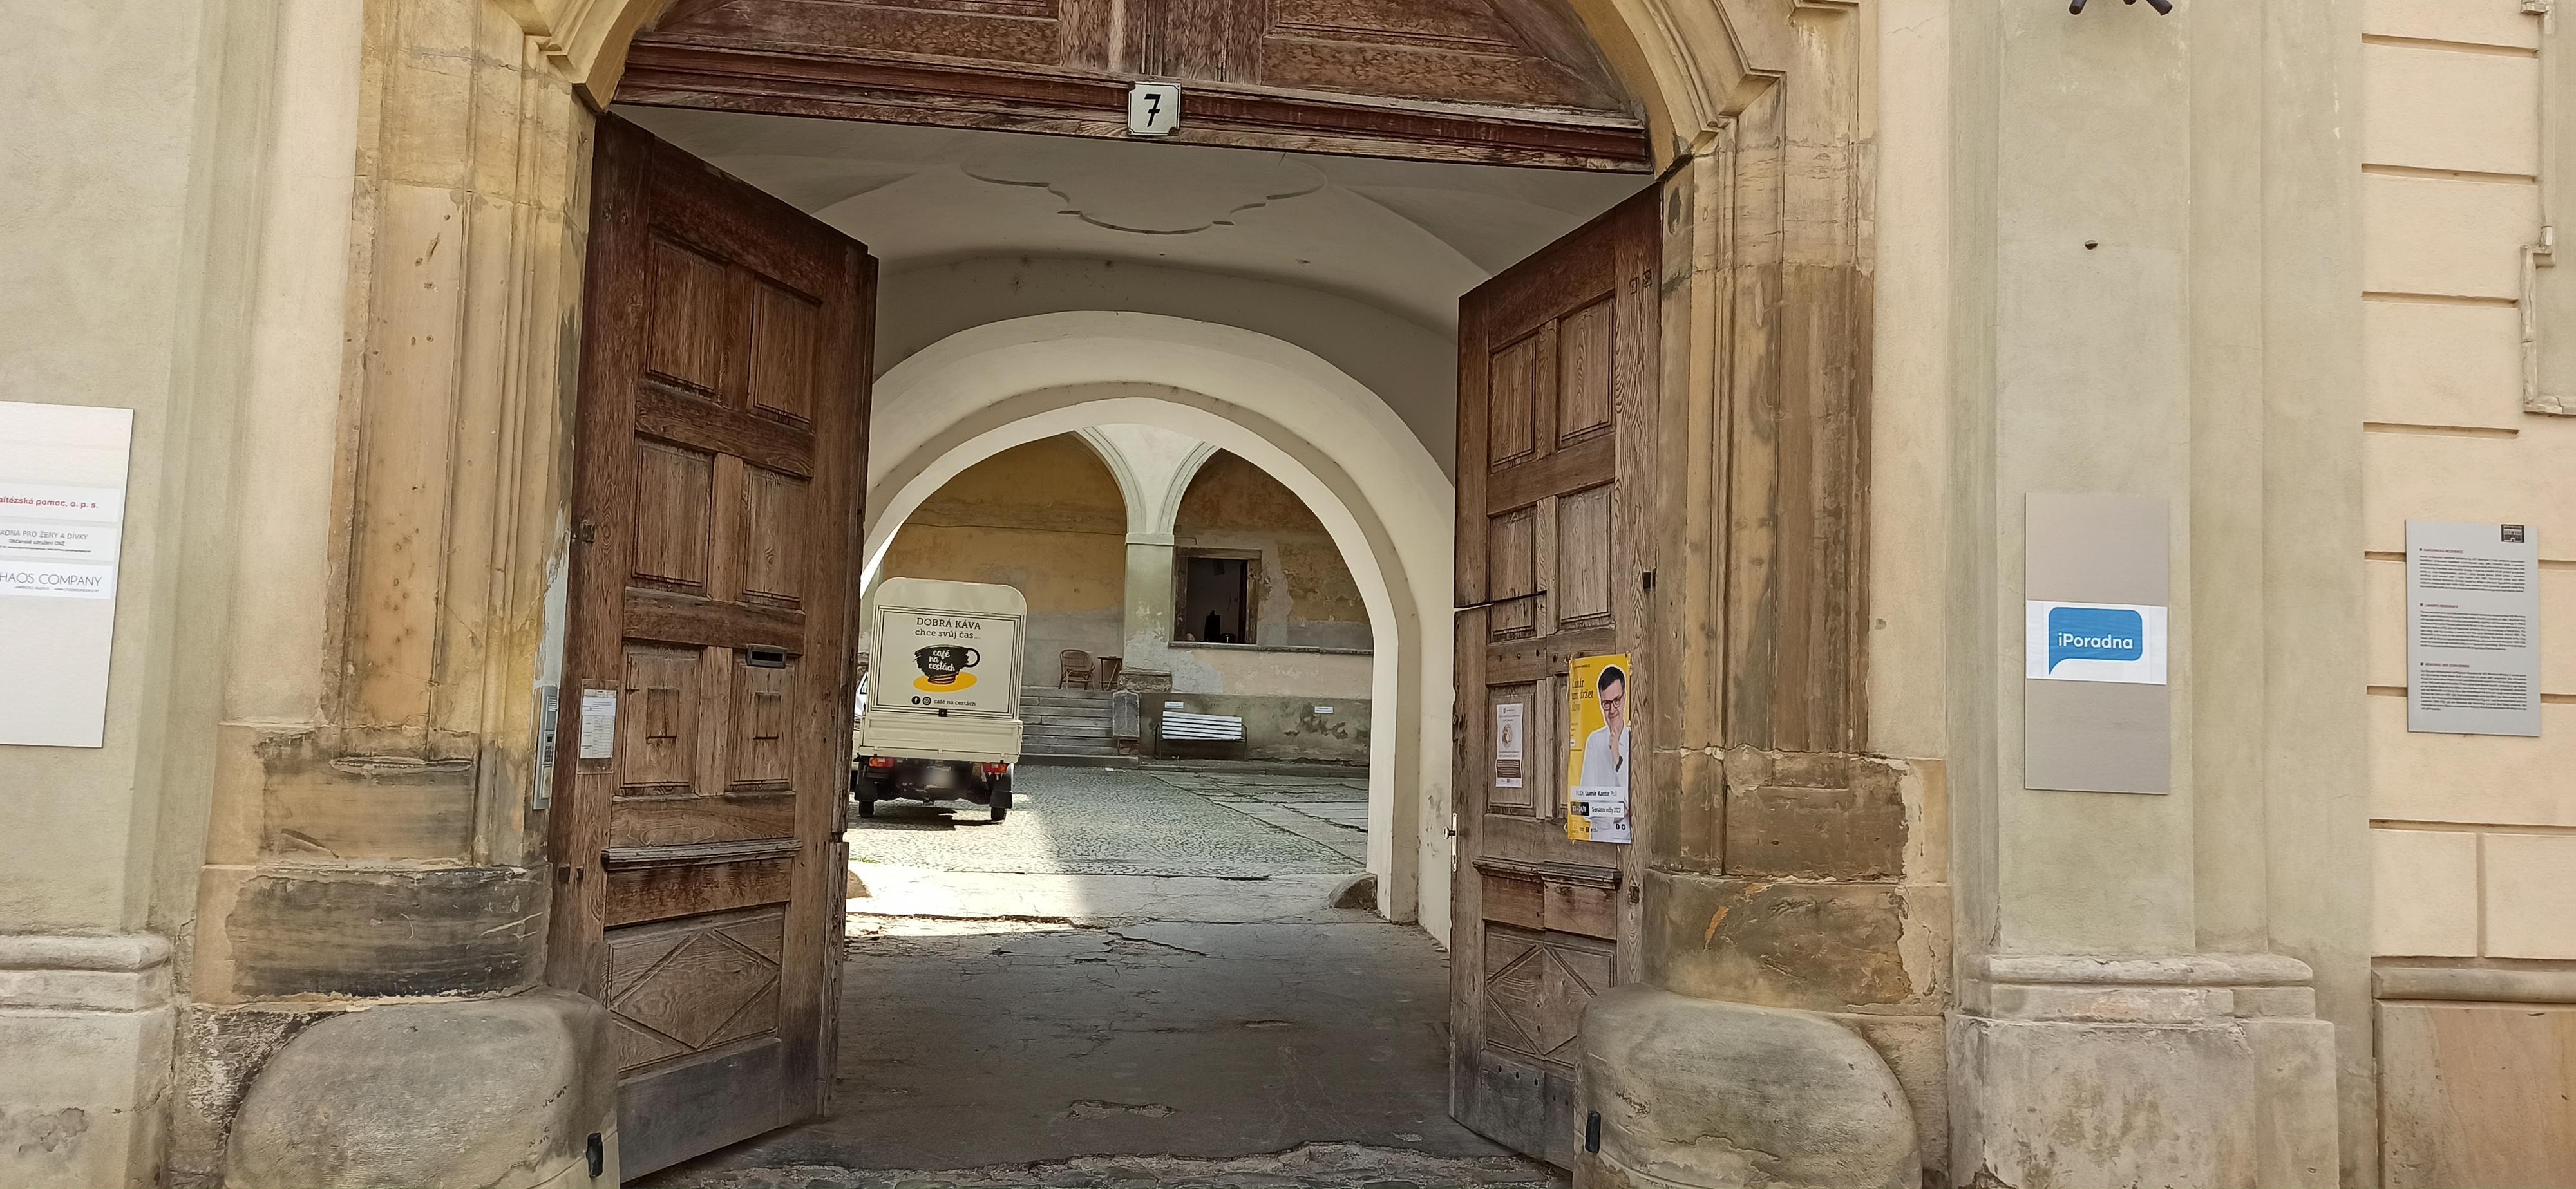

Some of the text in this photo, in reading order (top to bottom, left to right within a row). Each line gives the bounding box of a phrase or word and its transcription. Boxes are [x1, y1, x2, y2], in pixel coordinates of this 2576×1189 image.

[1144, 93, 1162, 128] 7
[35, 499, 68, 507] pomoc,
[39, 574, 102, 586] COMPANY
[916, 617, 981, 630] DOBRÁ KÁVA
[938, 630, 957, 639] svůj
[2058, 632, 2134, 650] iPoradna
[933, 650, 951, 659] café
[928, 660, 955, 671] cestách
